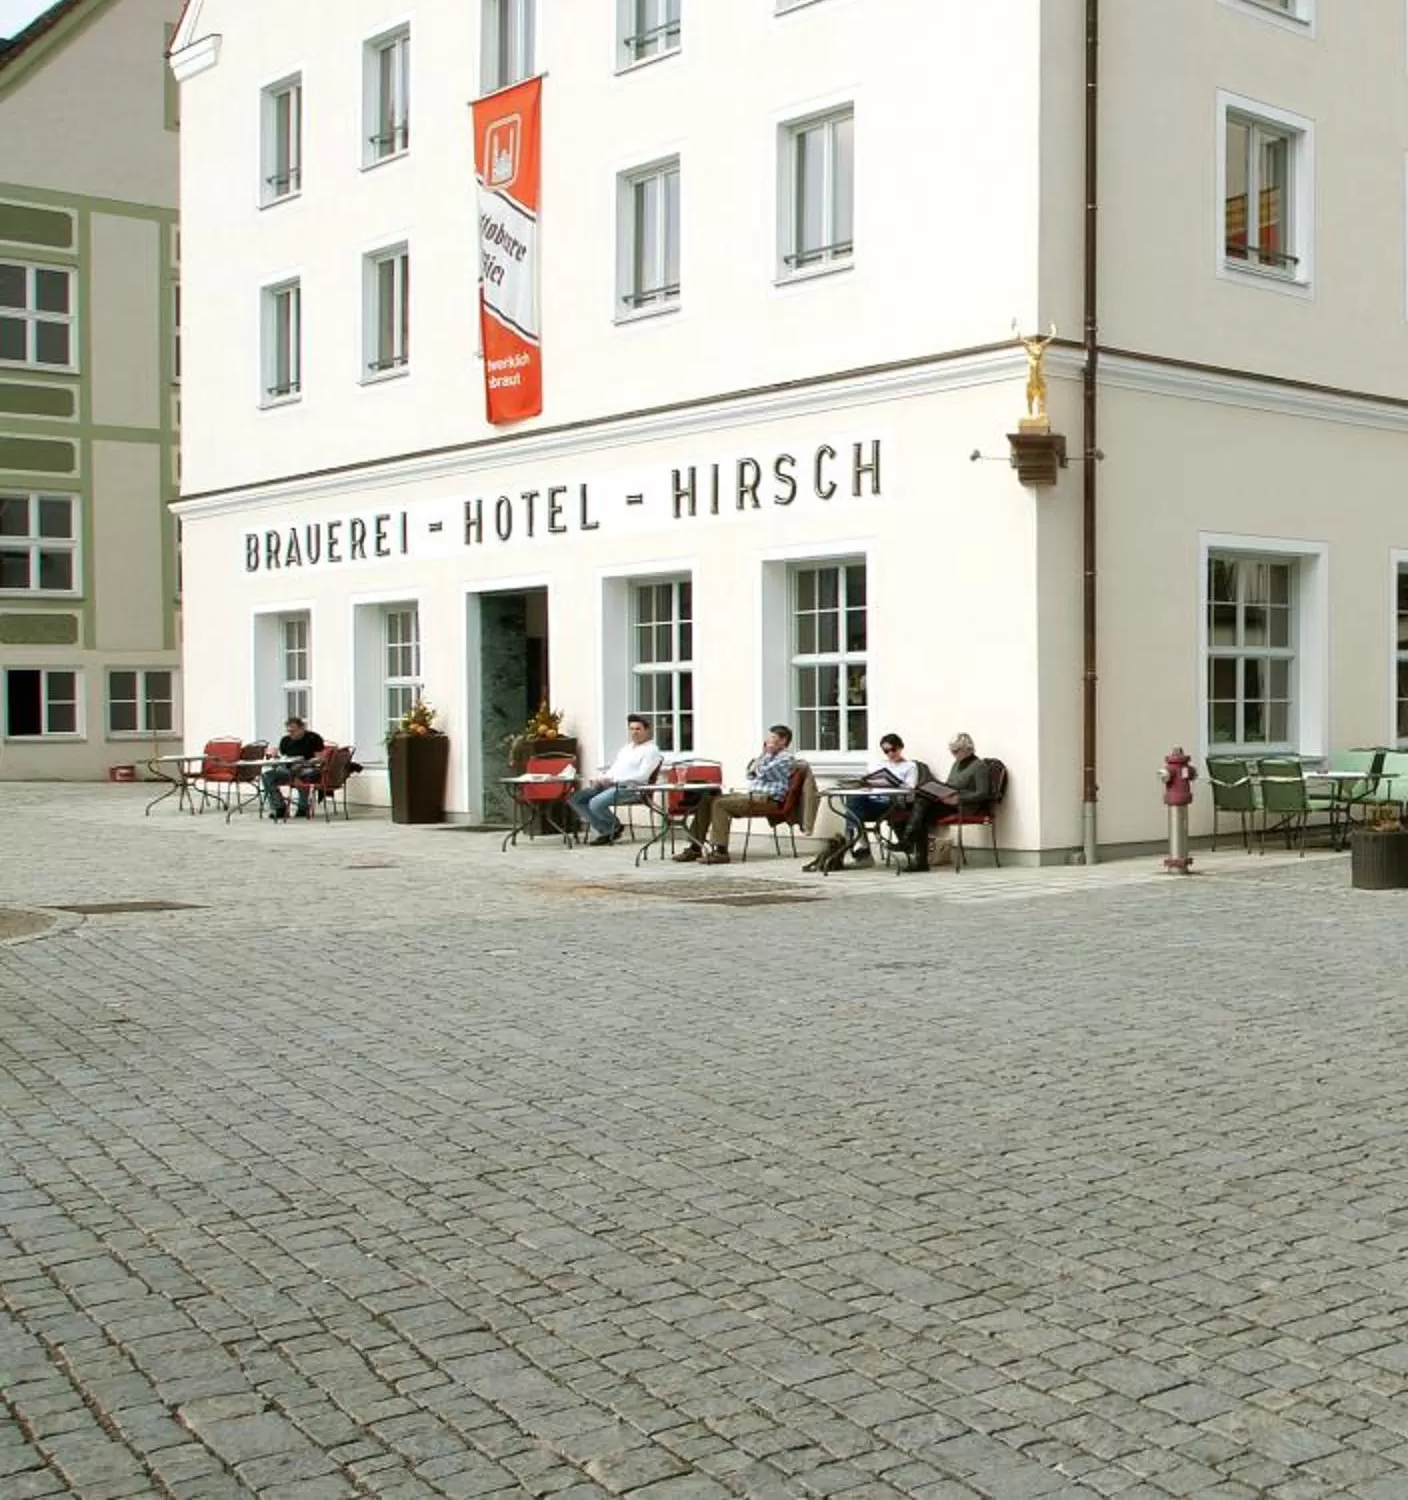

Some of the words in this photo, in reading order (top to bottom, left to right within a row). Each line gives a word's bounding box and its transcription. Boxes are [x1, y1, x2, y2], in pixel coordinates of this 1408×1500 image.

[245, 511, 408, 572] BRAUEREI
[463, 483, 600, 545] HOTEL
[672, 439, 881, 518] HIRSCH
